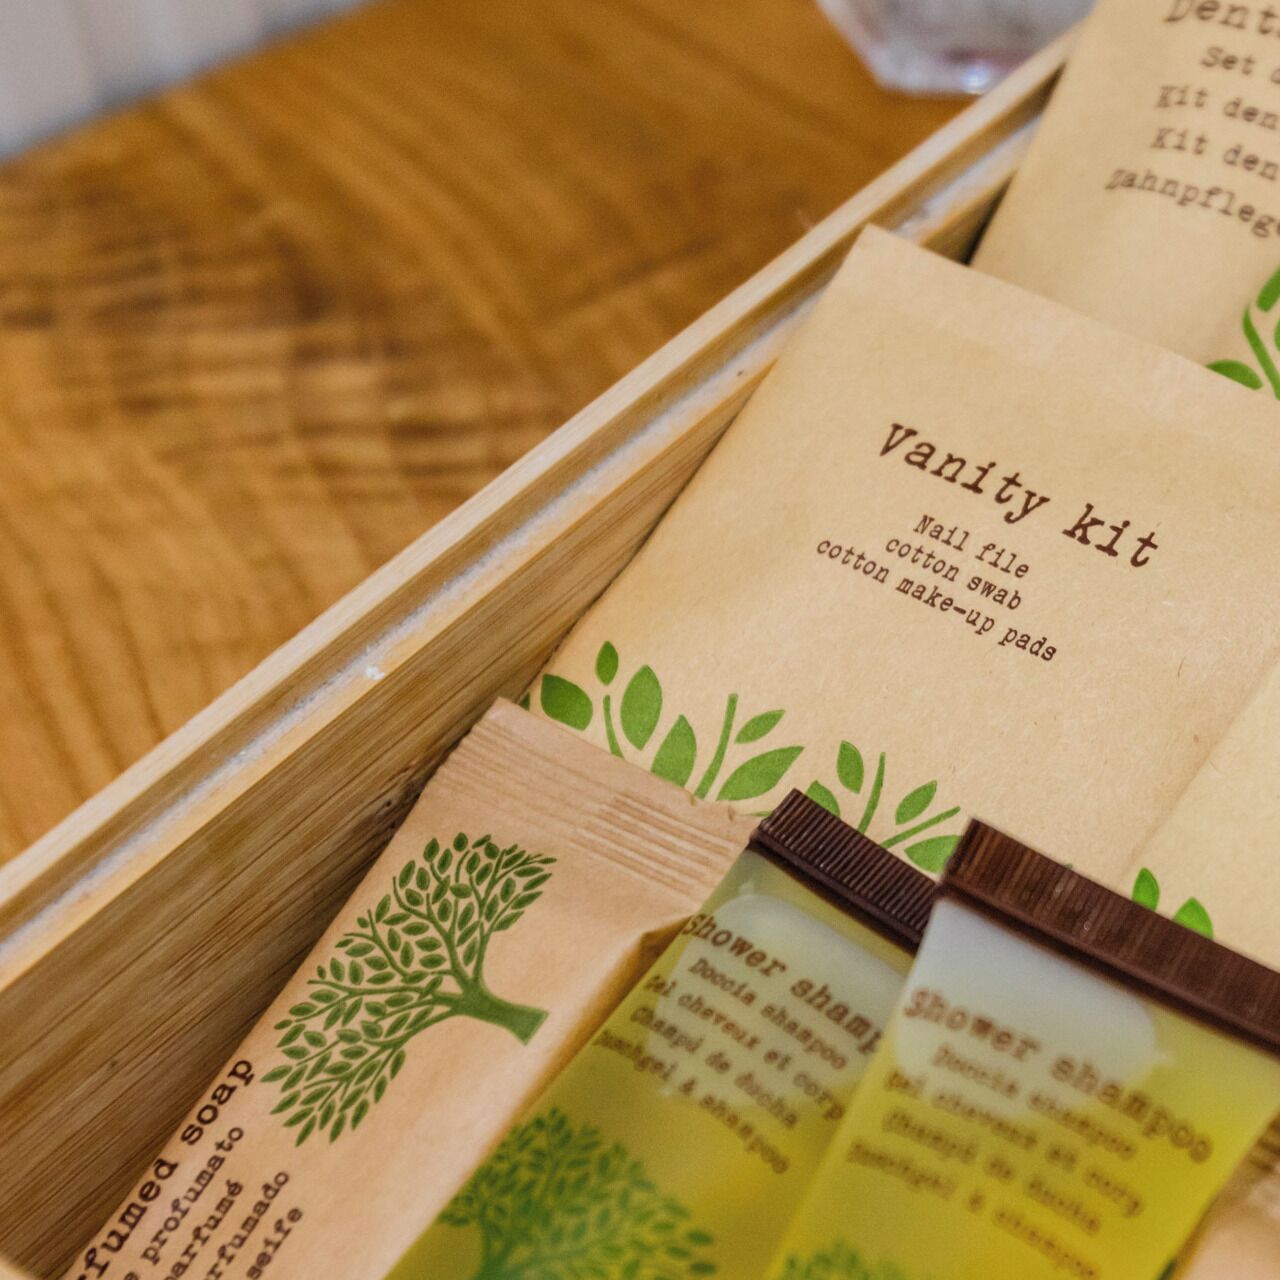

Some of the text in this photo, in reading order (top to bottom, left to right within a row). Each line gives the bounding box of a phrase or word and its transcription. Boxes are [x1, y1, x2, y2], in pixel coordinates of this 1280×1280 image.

[1156, 85, 1208, 109] Kit
[1201, 45, 1256, 75] Set
[1150, 127, 1208, 155] Kit
[879, 422, 1159, 568] Vanity kit
[885, 535, 1022, 611] cotton swab
[913, 514, 1030, 579] Nail file
[816, 537, 1058, 662] cotton make-up pads
[681, 913, 787, 977] Shower
[689, 958, 847, 1070] Doccia shampoo
[763, 1049, 793, 1071] et
[904, 987, 1213, 1165] Shower shampoo
[180, 1059, 255, 1147] soap
[140, 1126, 244, 1266] profumato
